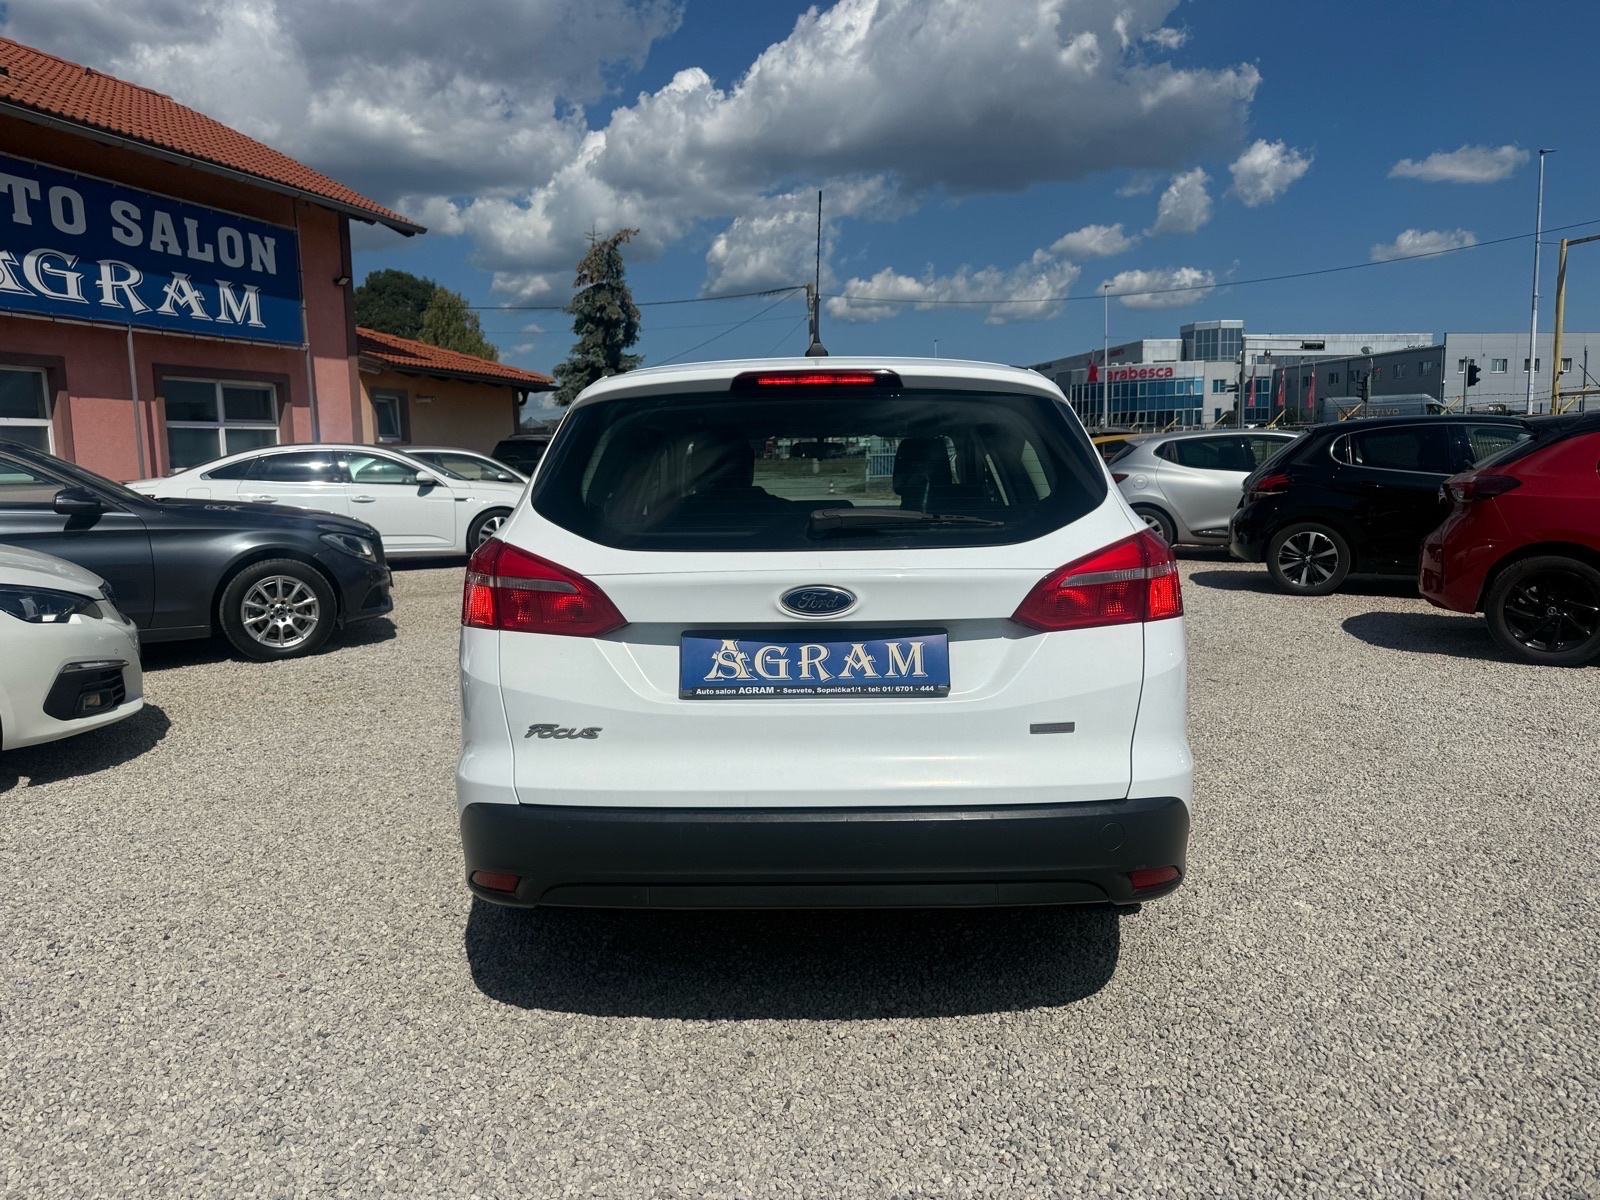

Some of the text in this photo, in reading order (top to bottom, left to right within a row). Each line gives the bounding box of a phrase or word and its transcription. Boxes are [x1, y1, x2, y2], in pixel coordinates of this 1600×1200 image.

[110, 200, 278, 275] SALON
[1107, 366, 1174, 381] arabesca
[797, 591, 839, 609] Ford
[738, 686, 775, 694] AGRAM
